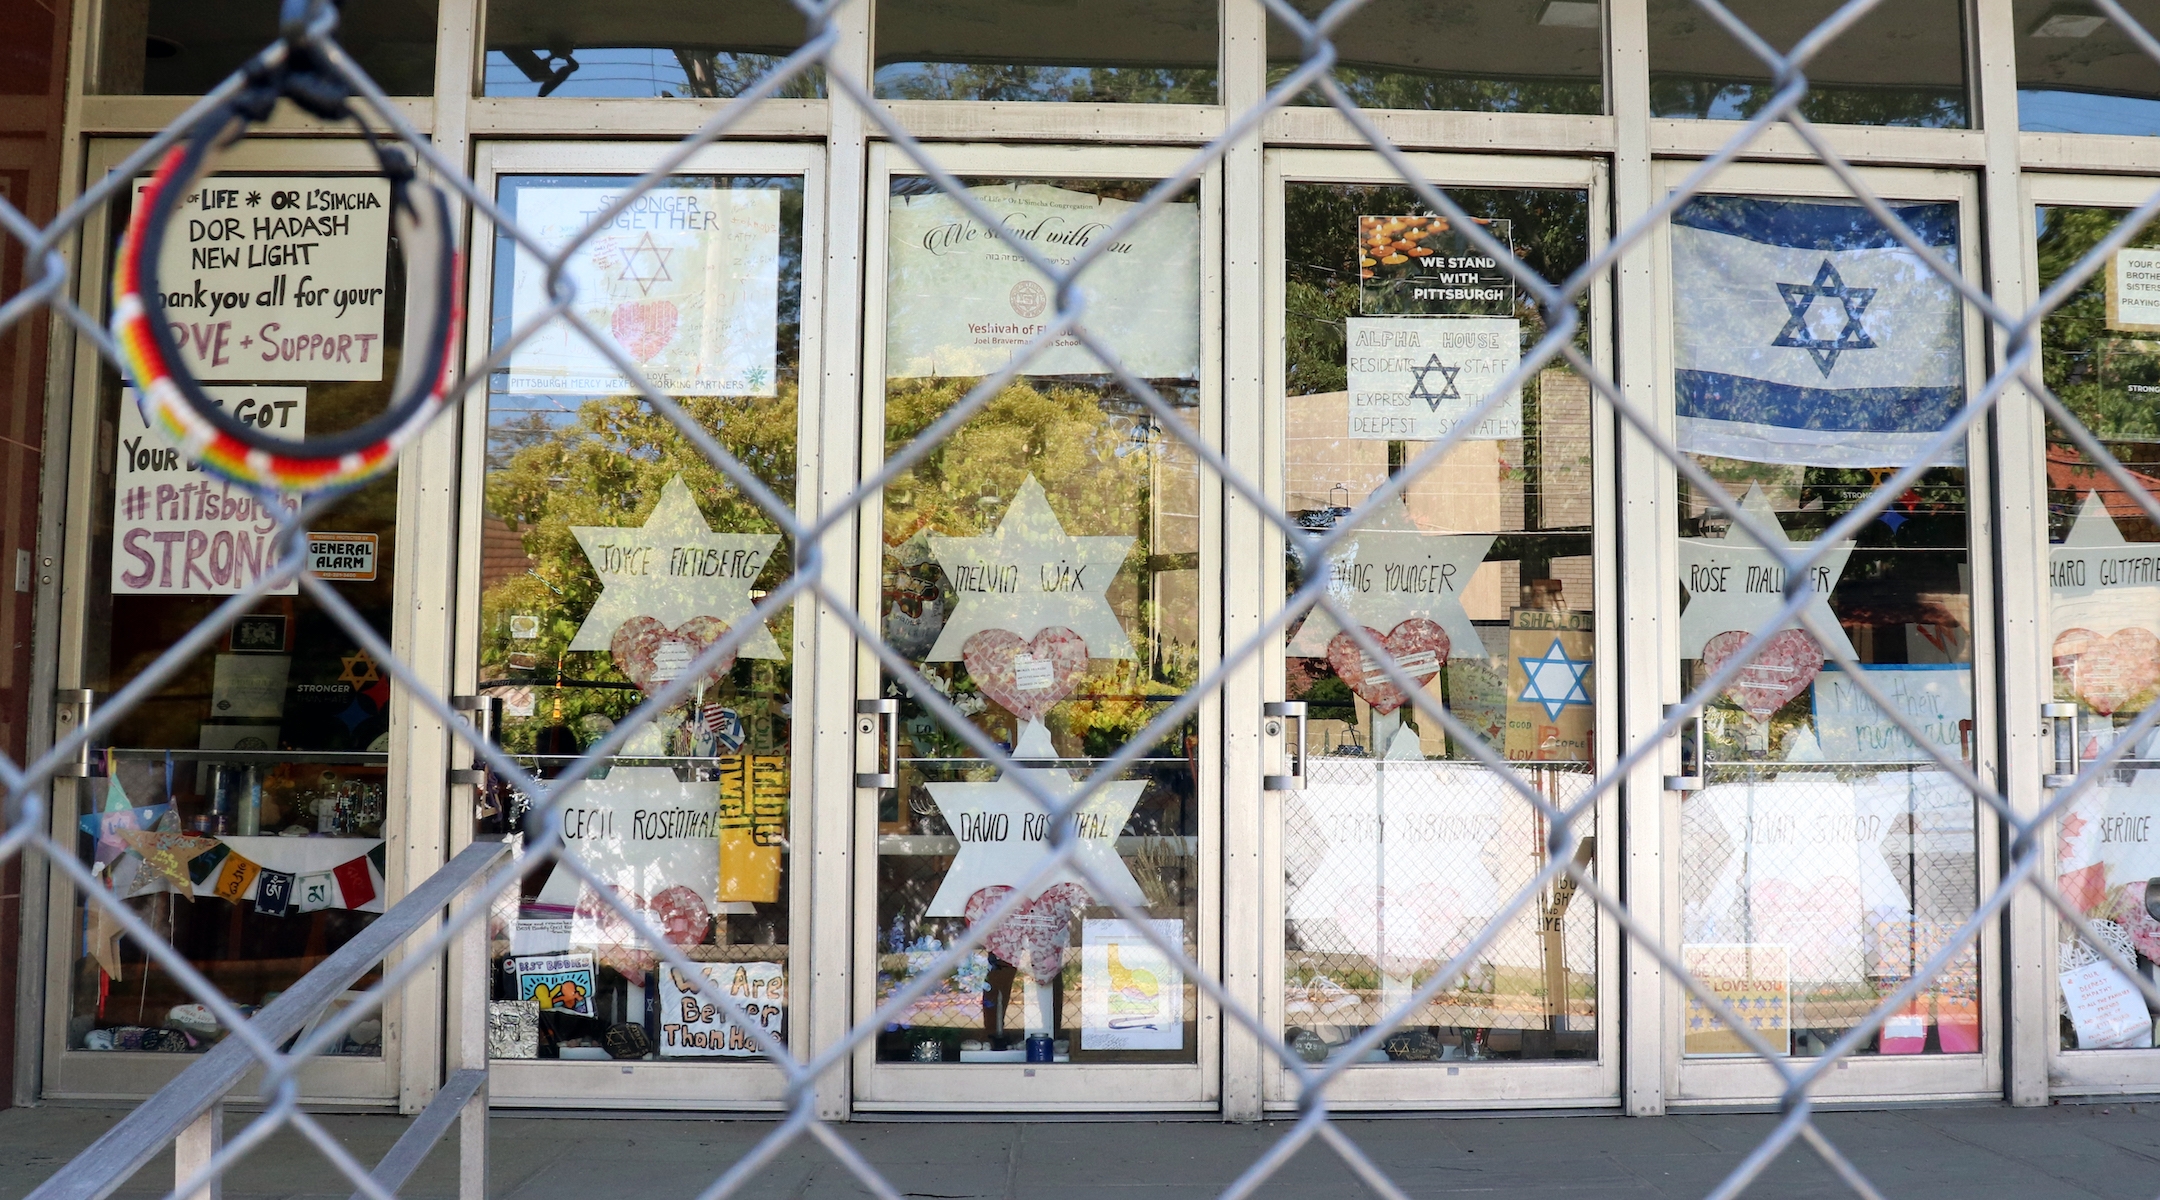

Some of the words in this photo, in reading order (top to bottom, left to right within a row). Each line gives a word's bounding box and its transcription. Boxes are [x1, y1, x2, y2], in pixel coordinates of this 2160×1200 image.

[202, 189, 239, 211] LIFE
[270, 190, 300, 211] OR
[306, 188, 382, 211] L'SIMCHA
[1050, 201, 1094, 210] Congregation
[189, 217, 246, 242] DOR
[253, 214, 350, 241] HADASH
[923, 220, 979, 256] We
[1046, 223, 1105, 247] with
[192, 247, 240, 270] NEW
[247, 242, 320, 269] LIGHT
[1420, 257, 1445, 268] WE
[1447, 257, 1496, 268] STAND
[2128, 260, 2152, 268] YOUR
[1440, 273, 1478, 284] WITH
[157, 279, 206, 310] hank
[210, 288, 250, 316] you
[255, 274, 286, 308] all
[294, 275, 330, 308] for
[333, 286, 384, 318] your
[1414, 289, 1504, 300] PITTSBURGH
[968, 323, 1019, 334] Yeshivah
[1022, 324, 1034, 335] of
[1356, 331, 1420, 348] ALPHA
[1442, 332, 1500, 349] HOUSE
[168, 320, 232, 368] OVE
[259, 322, 379, 364] SUPPORT
[1350, 358, 1415, 373] RESIDENTS
[1464, 359, 1510, 374] STAFF
[511, 378, 567, 388] PITTSBURGH
[571, 379, 600, 388] MERCY
[606, 379, 637, 388] WEXFO
[695, 380, 744, 390] PARTNERS
[1356, 393, 1412, 407] EXPRESS
[1464, 394, 1512, 408] THR
[234, 398, 298, 429] GOT
[1354, 418, 1417, 434] DEEPEST
[1438, 419, 1520, 436] SYPATHY
[123, 436, 180, 473] YOUR
[310, 542, 372, 556] GENERAL
[598, 544, 652, 576] JOYCE
[316, 556, 364, 569] ALARM
[954, 563, 1018, 594] MELVIN
[1040, 560, 1087, 593] WAX
[1384, 561, 1457, 595] YOUNGER
[1690, 563, 1732, 593] ROSE
[1519, 611, 1594, 630] SHALOM
[296, 684, 351, 693] STRONGER
[1834, 680, 1879, 725] May
[1890, 677, 1941, 717] their
[1855, 714, 1973, 756] memrie
[564, 807, 616, 840] CECIL
[632, 806, 720, 841] ROSENTHAL
[960, 812, 1009, 842] DAVID
[1022, 812, 1108, 842] ROSTHAL
[518, 962, 544, 972] BEST
[730, 966, 782, 1000] Are
[1714, 980, 1749, 992] LOVE
[1752, 980, 1784, 992] YOU
[680, 996, 779, 1028] Beter
[663, 1024, 725, 1050] Than
[728, 1026, 783, 1053] Hae
